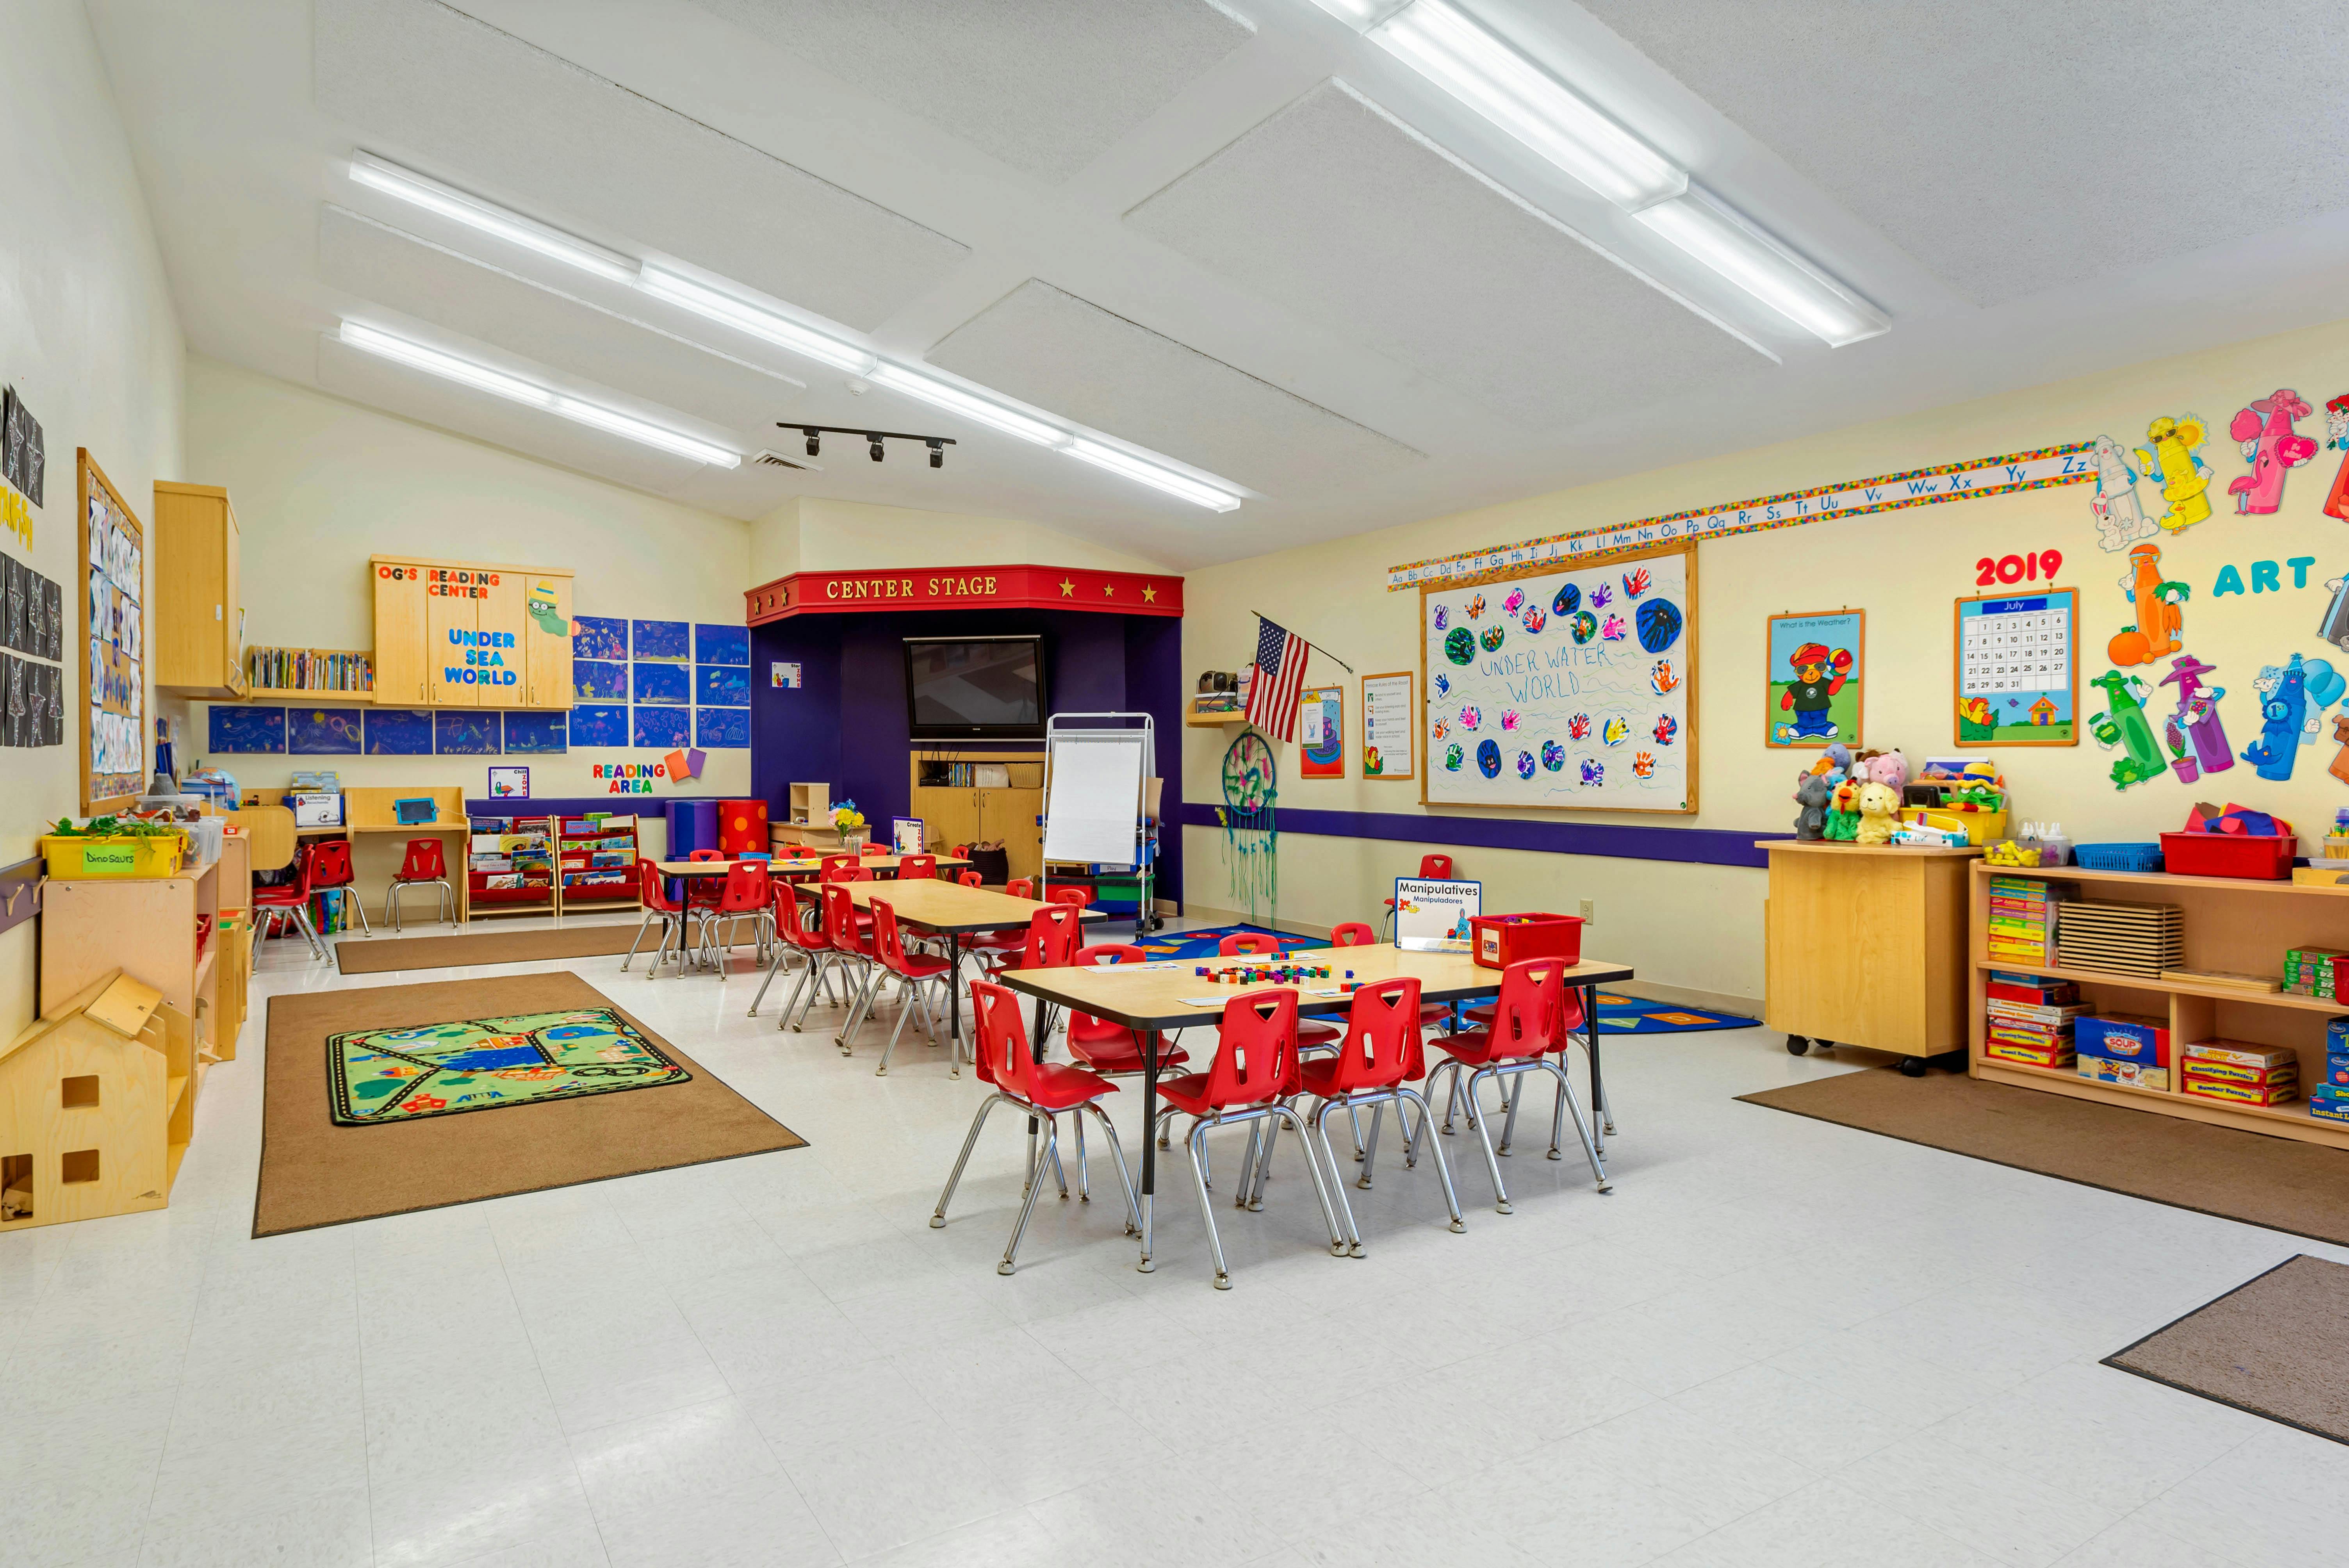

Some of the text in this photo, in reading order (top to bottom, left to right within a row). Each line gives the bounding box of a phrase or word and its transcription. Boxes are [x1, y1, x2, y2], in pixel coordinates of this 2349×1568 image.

[1392, 456, 2087, 584] Aa Bb Cc Dd Ee Ff Gg Hh Ii Jj Kk Ll Mm Nn Oo Pp Qq Rr Ss Tt Uu Vv Ww Xx Yy Zz
[1976, 549, 2062, 586] 2019
[378, 566, 500, 586] OG'S READING
[2213, 556, 2315, 597] ART
[428, 584, 488, 599] CENTER
[826, 576, 997, 599] CENTER STAGE
[2004, 600, 2025, 611] July
[1818, 618, 1851, 626] Weather?
[449, 629, 515, 648] UNDER
[466, 649, 504, 666] SEA
[1480, 642, 1613, 676] UNDER WATER
[444, 667, 517, 685] WORLD
[1506, 671, 1581, 703] WORLD
[593, 764, 665, 778] READING
[609, 779, 653, 794] AREA
[1399, 882, 1477, 896] Manipulatives
[1413, 895, 1463, 905] Manipuladores
[2109, 1038, 2136, 1048] SOUP
[2018, 1051, 2038, 1060] Puzzles
[2198, 1052, 2227, 1061] MATCH
[2112, 1063, 2120, 1072] Z
[2191, 1066, 2253, 1080] Classifying Puzzles
[2226, 1087, 2252, 1099] Puzzles
[2312, 1108, 2343, 1119] Instant
